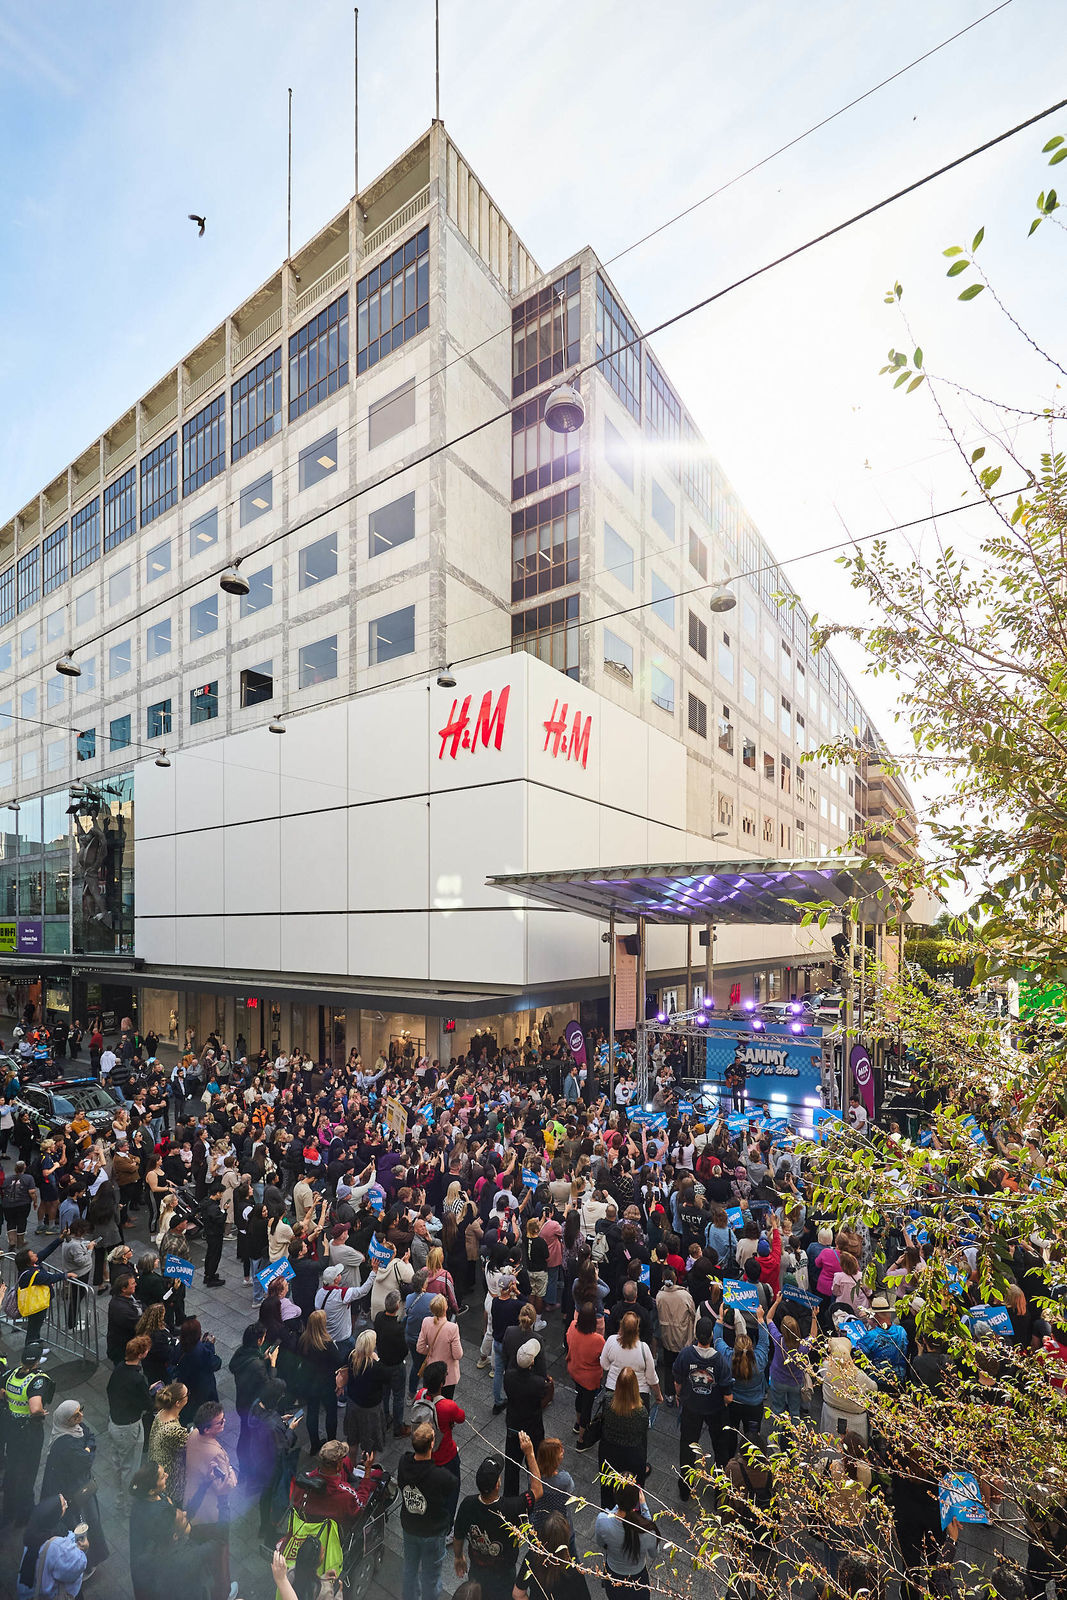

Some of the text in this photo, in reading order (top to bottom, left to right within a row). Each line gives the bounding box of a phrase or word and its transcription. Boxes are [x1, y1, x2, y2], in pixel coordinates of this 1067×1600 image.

[438, 684, 510, 760] H&M
[544, 698, 592, 770] H&M
[736, 1048, 788, 1066] SAMMY
[746, 1064, 798, 1076] Boy in Blue
[89, 1116, 114, 1124] POLIC
[274, 1262, 289, 1276] HERO
[735, 1290, 757, 1301] SAMMY
[784, 1290, 799, 1298] OUR
[988, 1312, 1008, 1326] HERO
[844, 1325, 852, 1334] GO
